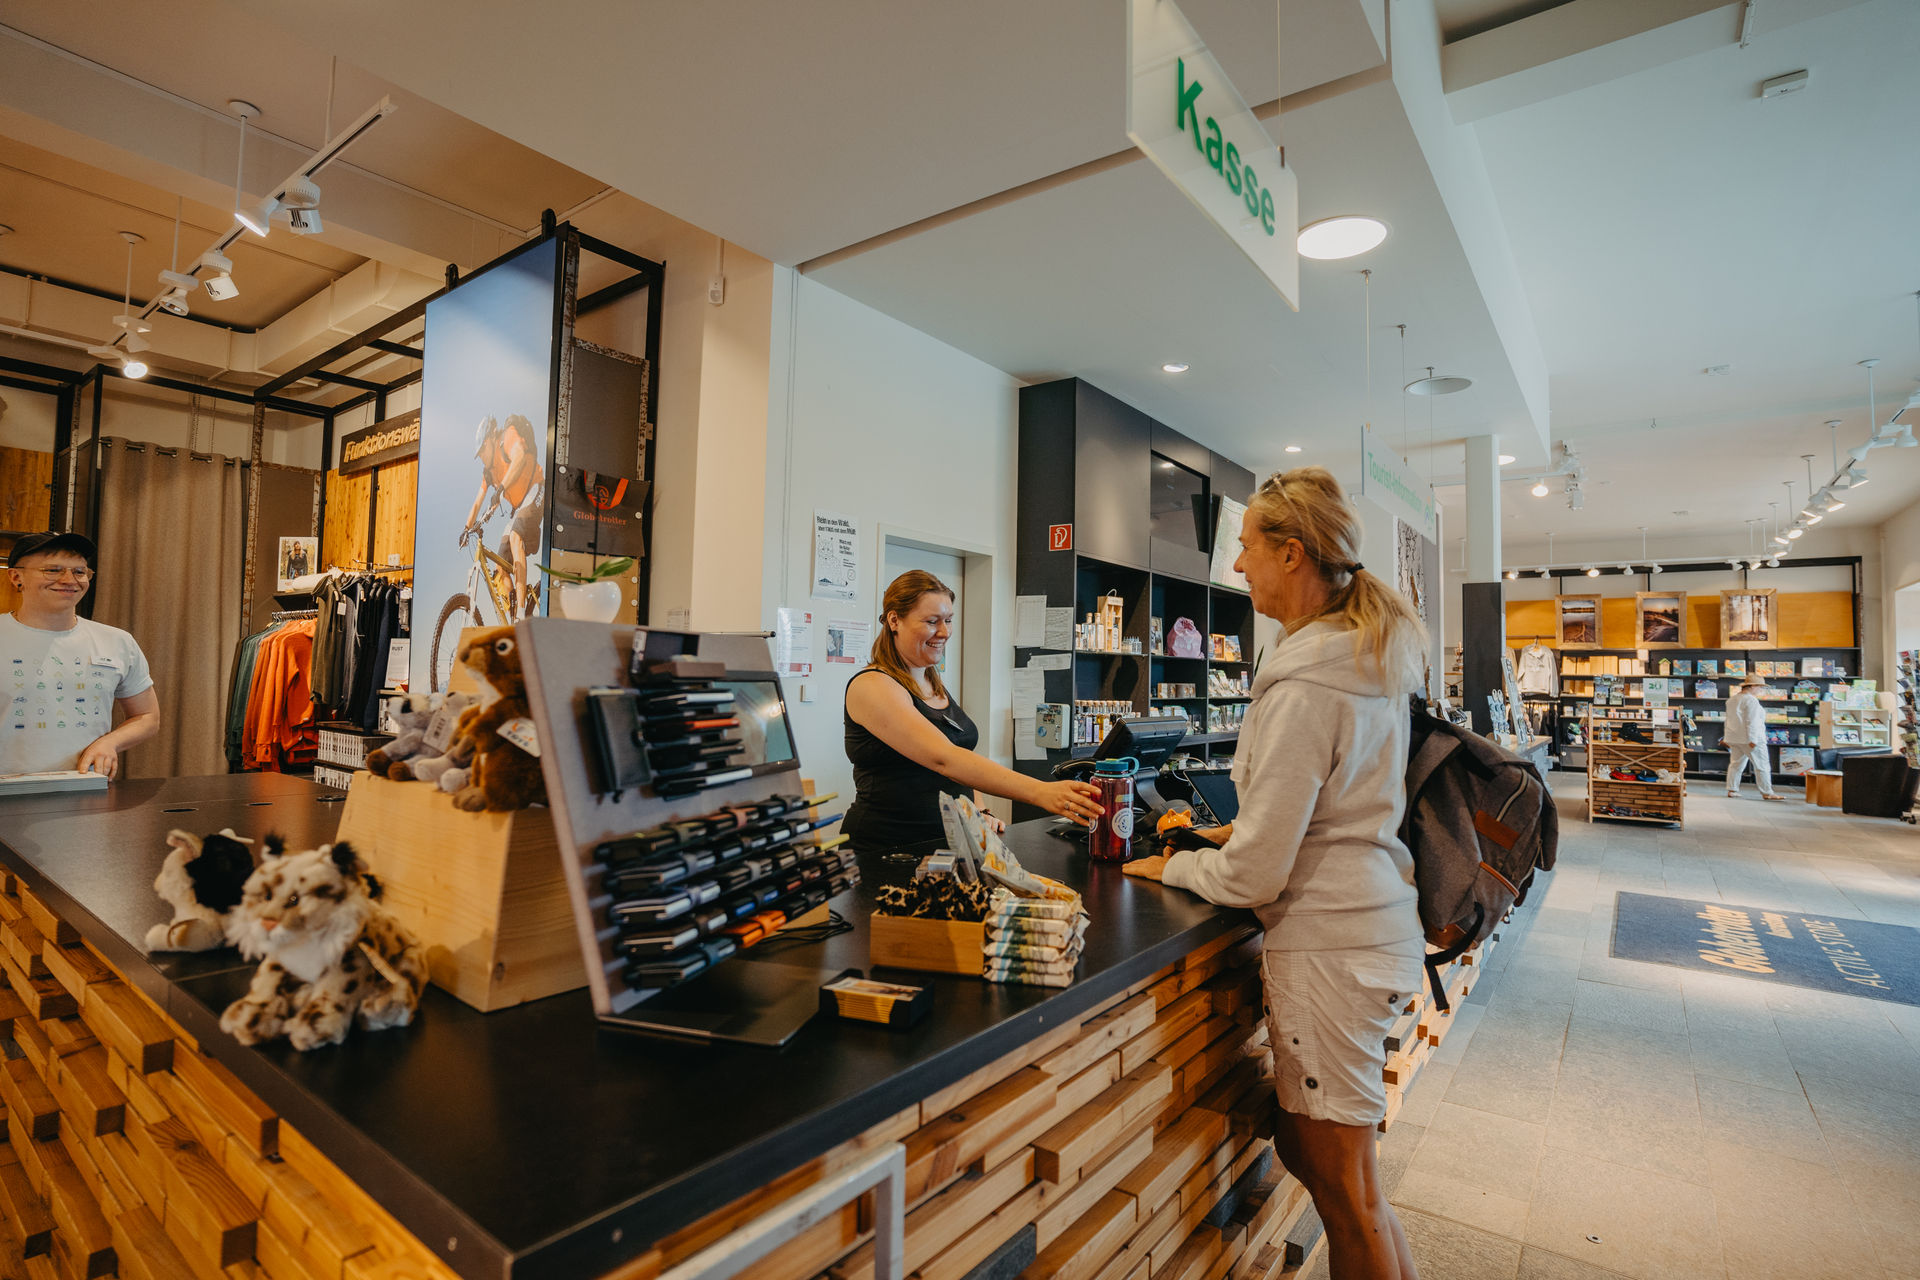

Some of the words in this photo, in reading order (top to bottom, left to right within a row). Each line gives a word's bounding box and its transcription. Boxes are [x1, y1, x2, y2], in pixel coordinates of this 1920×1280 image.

[1177, 57, 1275, 236] Kasse
[344, 418, 420, 463] Funktionswä
[573, 510, 627, 526] Globtrotter
[1696, 905, 1776, 974] Globetrotter
[1801, 918, 1855, 949] STORE
[1821, 945, 1890, 990] ACTIVE
